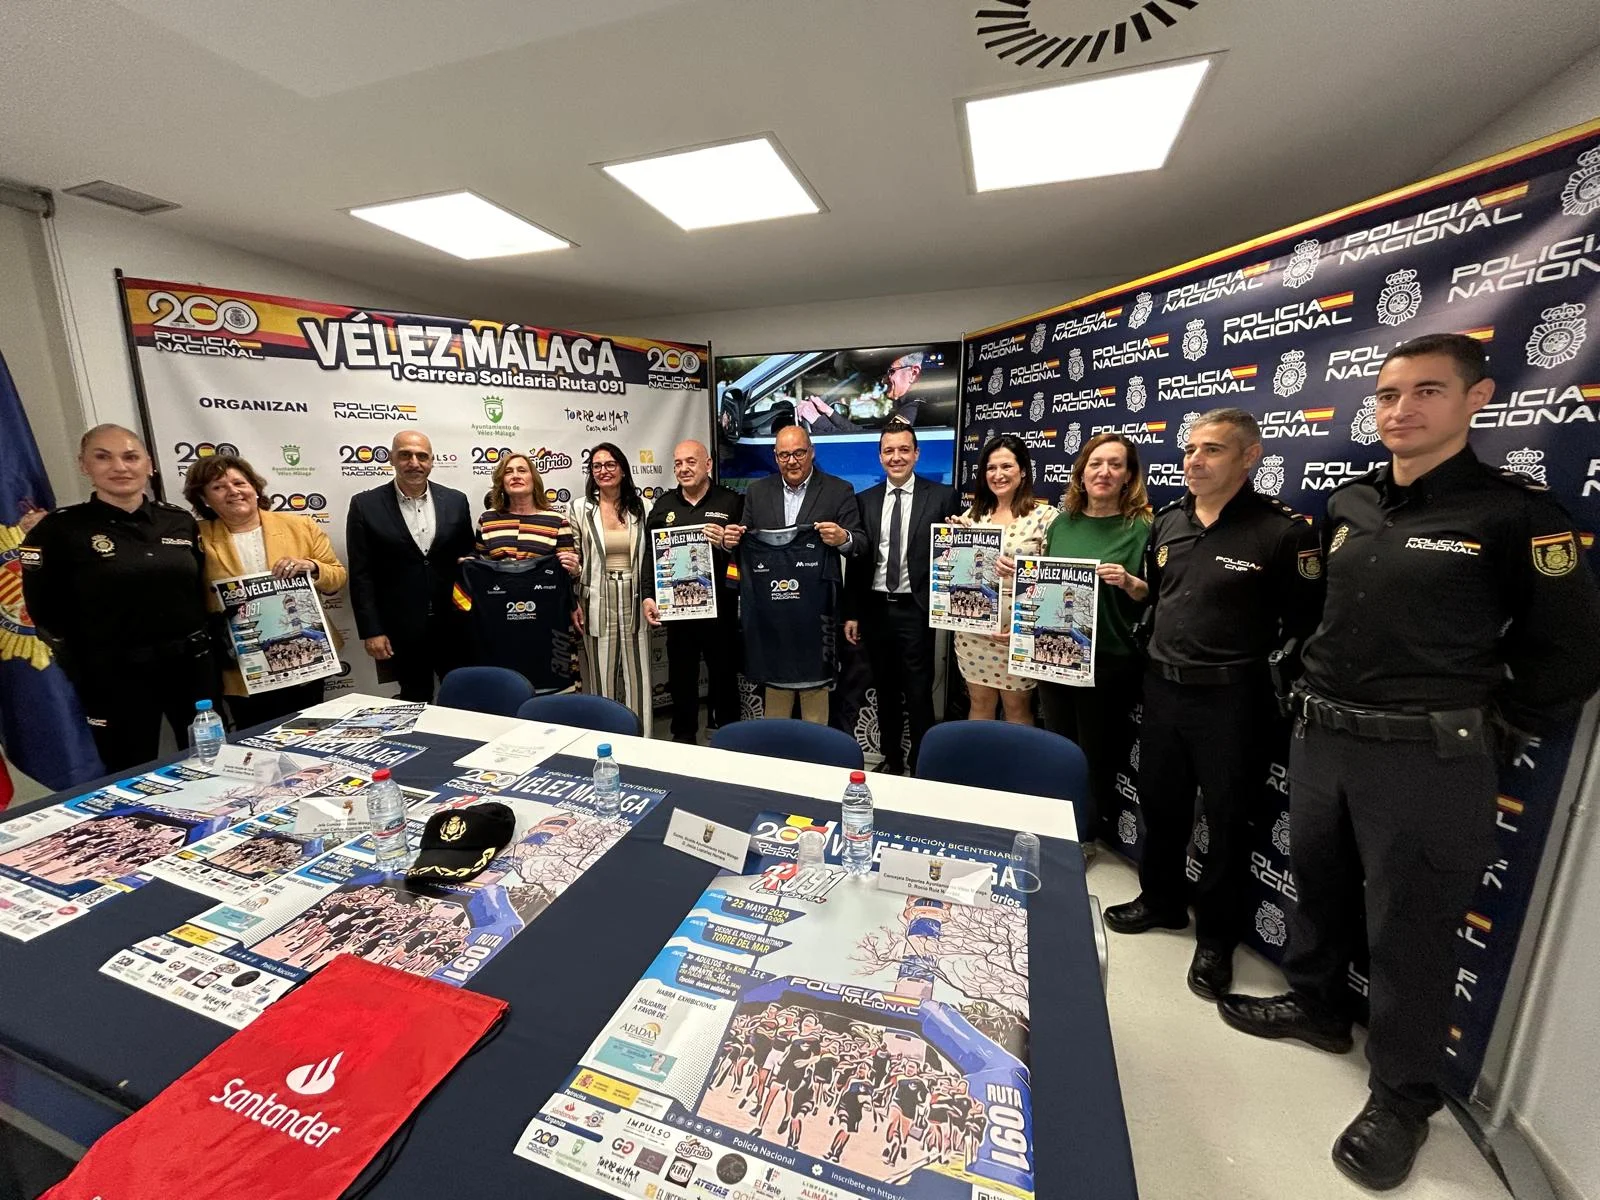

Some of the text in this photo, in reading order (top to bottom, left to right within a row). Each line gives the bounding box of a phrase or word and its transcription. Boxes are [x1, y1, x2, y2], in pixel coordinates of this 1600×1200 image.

[1344, 197, 1482, 249] POLICIA
[1340, 207, 1522, 265] NACIONAL
[1451, 234, 1600, 284] POLICI
[1166, 270, 1244, 302] POLICIA
[1448, 257, 1600, 303] NACION
[1161, 277, 1263, 314] NACIONAL
[147, 291, 259, 335] 200
[1054, 311, 1106, 333] POLICIA
[1223, 298, 1322, 332] POLICIA
[1052, 319, 1117, 342] NACIONAL
[1223, 311, 1353, 346] NACIONAL
[154, 331, 242, 348] POLICIA
[303, 312, 621, 377] VÉLEZ MÁLAGA
[981, 336, 1016, 352] POLICIA
[1092, 338, 1150, 359] POLICIA
[156, 341, 265, 359] NACIONAL
[979, 343, 1024, 361] NACIONAL
[1093, 347, 1169, 370] NACIONAL
[647, 348, 700, 373] 200
[1010, 361, 1049, 377] POLICIA
[402, 366, 476, 385] Carrera
[479, 369, 556, 390] Solidaria
[559, 376, 597, 391] Ruta
[599, 380, 625, 393] 091
[648, 374, 691, 383] POLICIA
[648, 381, 701, 391] NACIONAL
[1010, 369, 1060, 386] NACIONAL
[1158, 368, 1234, 389] POLICIA
[1053, 388, 1102, 403] POLICIA
[1158, 379, 1255, 401] NACIONAL
[199, 397, 308, 413] ORGANIZAN
[333, 402, 400, 412] POLICIA
[976, 401, 1012, 413] POLICIA
[1052, 397, 1116, 413] NACIONAL
[334, 410, 417, 421] NACIONAL
[975, 410, 1022, 421] NACIONAL
[1091, 422, 1149, 434] POLICIA
[339, 445, 391, 464] 200
[632, 465, 662, 475] EL INGENIO
[672, 533, 686, 545] VÉLEZ
[954, 533, 1000, 545] VÉLEZ MÁLAGA
[1408, 537, 1464, 548] POLICIA
[1405, 542, 1479, 555] NACIONAL
[1215, 556, 1256, 569] POLICIA
[1040, 566, 1093, 583] VÉLEZ MÁLAGA
[245, 581, 273, 597] VÉLEZ
[770, 579, 799, 593] 200
[506, 601, 536, 613] 200
[511, 772, 571, 798] VÉLEZ
[905, 834, 1022, 861] EDICIÓN BICENTENARIO
[731, 899, 790, 919] 25 MAYO 2024
[475, 934, 503, 948] RUTA
[714, 925, 732, 934] DESDE
[739, 930, 756, 941] PASEO
[712, 932, 770, 954] TORRE DEL MAR
[695, 953, 722, 967] ADULTOS
[790, 978, 885, 1002] POLICIA
[637, 997, 667, 1012] SOLIDARIA
[656, 989, 716, 1011] HABRÁ EXHIBICIONES
[842, 995, 918, 1016] NACIONAL
[638, 1006, 656, 1016] FAVOR
[986, 1083, 1023, 1110] RUTA
[209, 1078, 341, 1148] Santander
[544, 1115, 566, 1128] Organiza
[626, 1118, 671, 1139] IMPULSO
[532, 1129, 559, 1147] 200
[988, 1105, 1031, 1172] 091
[676, 1141, 712, 1159] Sigfrido
[733, 1137, 796, 1166] Policía Nacional
[693, 1178, 730, 1197] ATENAS
[866, 1184, 876, 1193] en
